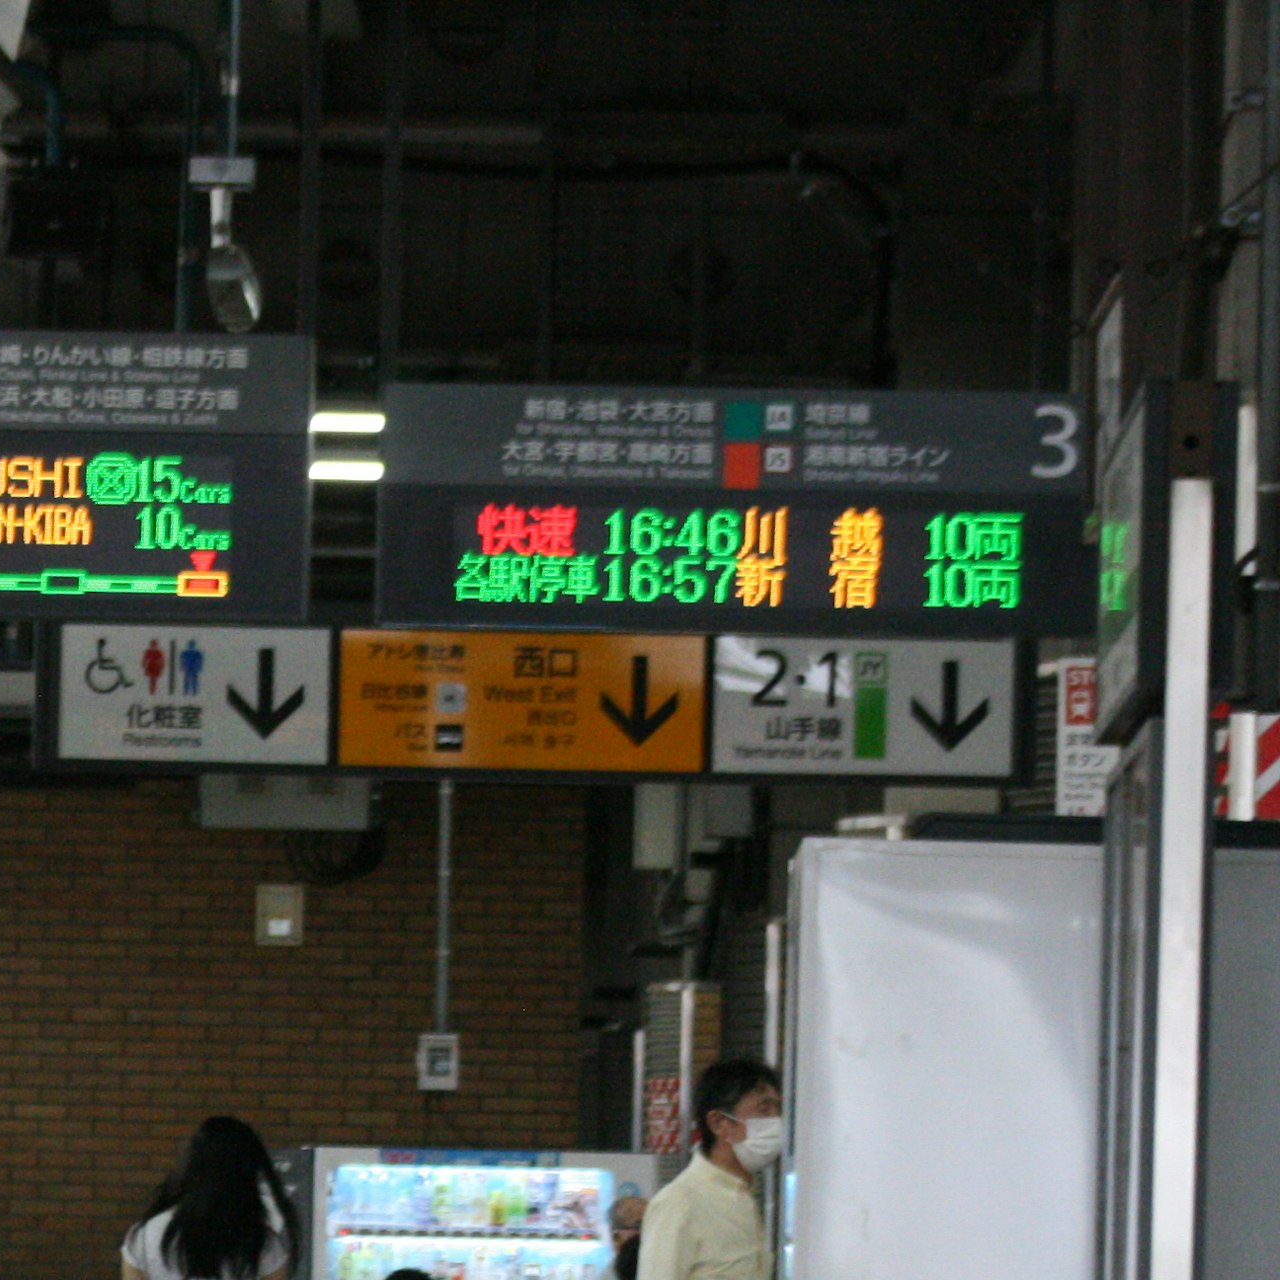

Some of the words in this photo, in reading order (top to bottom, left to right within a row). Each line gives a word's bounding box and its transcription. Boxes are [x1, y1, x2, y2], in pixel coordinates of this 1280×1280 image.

[1030, 403, 1079, 479] 3
[477, 503, 578, 557] 快速
[603, 508, 740, 556] 16:46
[923, 510, 1027, 561] 10両
[453, 550, 600, 604] 各駅停車
[602, 555, 740, 604] 16:57
[922, 558, 1023, 609] 10両
[514, 645, 578, 678] 西口
[483, 685, 535, 703] West
[542, 686, 579, 703] Exit
